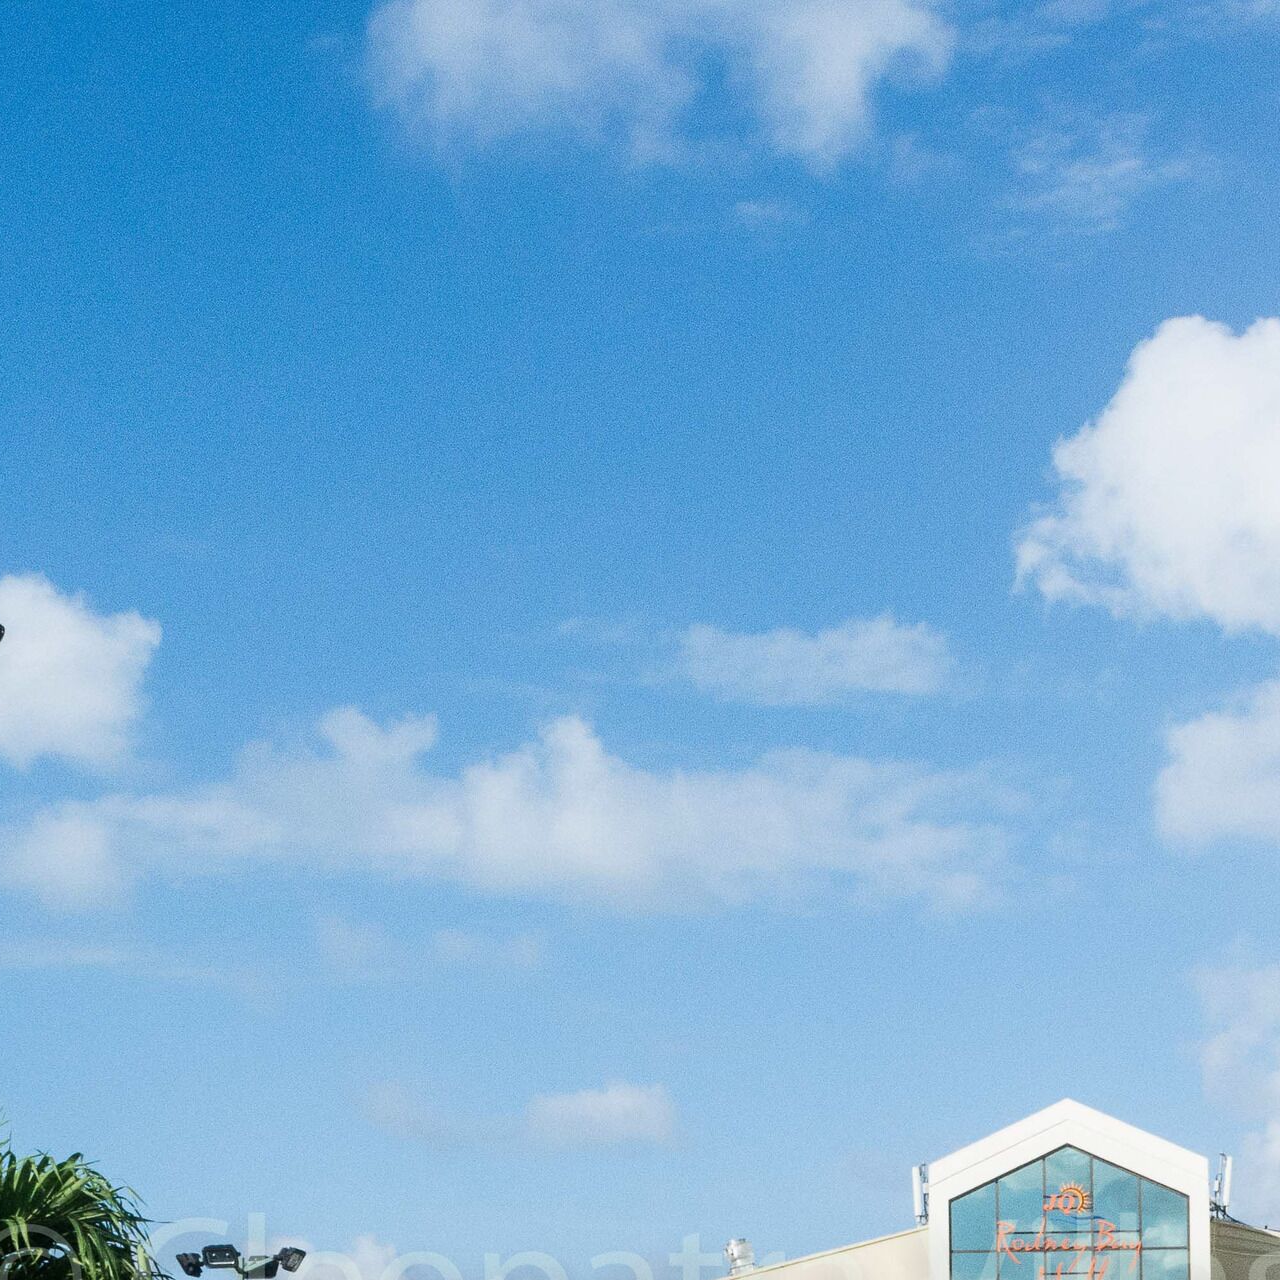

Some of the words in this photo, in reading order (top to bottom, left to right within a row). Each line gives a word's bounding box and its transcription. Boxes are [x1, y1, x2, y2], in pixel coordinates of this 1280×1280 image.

[1043, 1193, 1076, 1215] JQ
[996, 1215, 1088, 1273] Rodney
[1096, 1218, 1143, 1274] Bay
